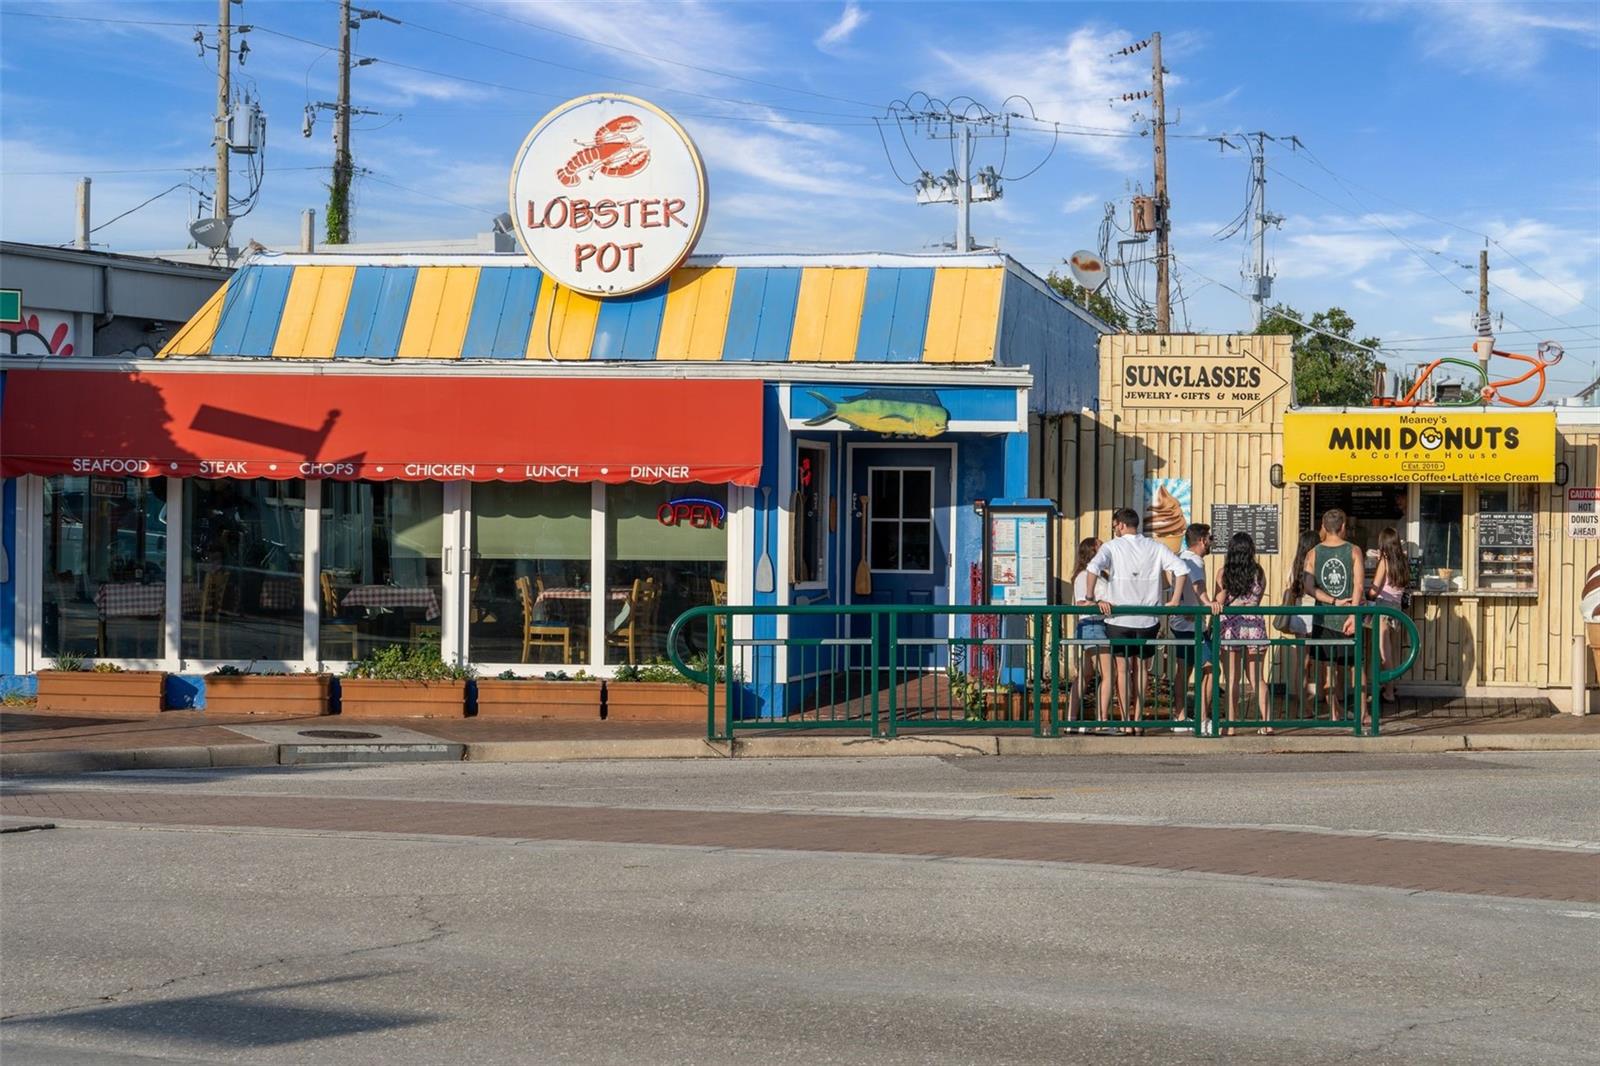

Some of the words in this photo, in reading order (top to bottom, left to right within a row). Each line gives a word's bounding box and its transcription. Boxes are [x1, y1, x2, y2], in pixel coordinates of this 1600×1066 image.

[527, 198, 689, 229] LOBSTER
[574, 242, 643, 273] POT
[1125, 365, 1261, 388] SUNGLASSES
[1125, 391, 1173, 400] JEWELRY
[1181, 392, 1210, 400] GIFTS
[1216, 392, 1226, 400] &
[1231, 393, 1261, 401] MORE
[1399, 415, 1448, 425] Meaney's
[1328, 427, 1391, 451] MINI
[1399, 426, 1520, 451] DONUTS
[1350, 451, 1357, 459] &
[1371, 451, 1431, 459] Coffee
[1444, 451, 1498, 459] House
[72, 458, 150, 473] SEAFOOD
[199, 460, 248, 474] STEAK
[299, 463, 354, 475] CHOPS
[404, 464, 475, 477] CHICKEN
[525, 465, 579, 478] LUNCH
[630, 466, 690, 478] DINNER
[1299, 472, 1334, 482] Coffee
[1339, 472, 1389, 484] Espresso
[1393, 472, 1410, 482] Ice
[1411, 472, 1447, 482] Coffee
[1484, 472, 1501, 482] Ice
[1503, 472, 1540, 482] Cream
[1577, 503, 1592, 511] HOT
[656, 502, 722, 529] OPEN
[1571, 515, 1599, 524] DONUTS
[1573, 527, 1597, 536] AHEAD
